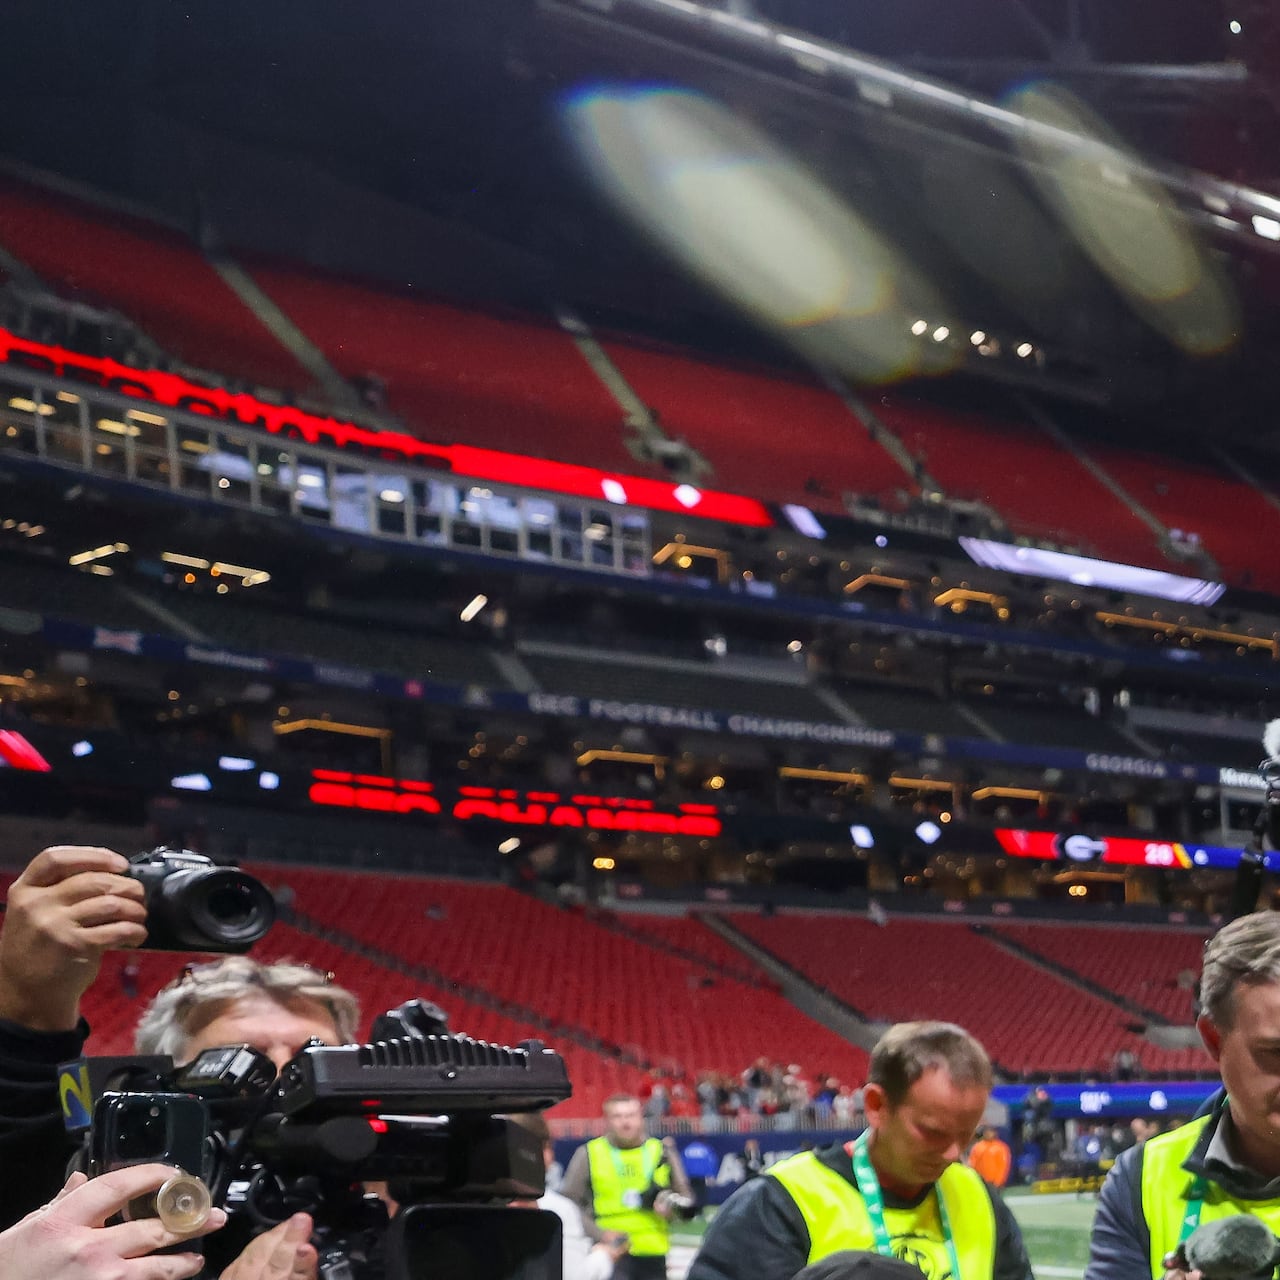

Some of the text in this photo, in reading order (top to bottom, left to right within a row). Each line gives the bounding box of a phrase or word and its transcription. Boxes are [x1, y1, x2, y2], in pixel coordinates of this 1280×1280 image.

[589, 699, 720, 732] FOOTBALL
[728, 713, 895, 747] CHAMPIONSHIP
[1086, 753, 1168, 778] GEORGIA
